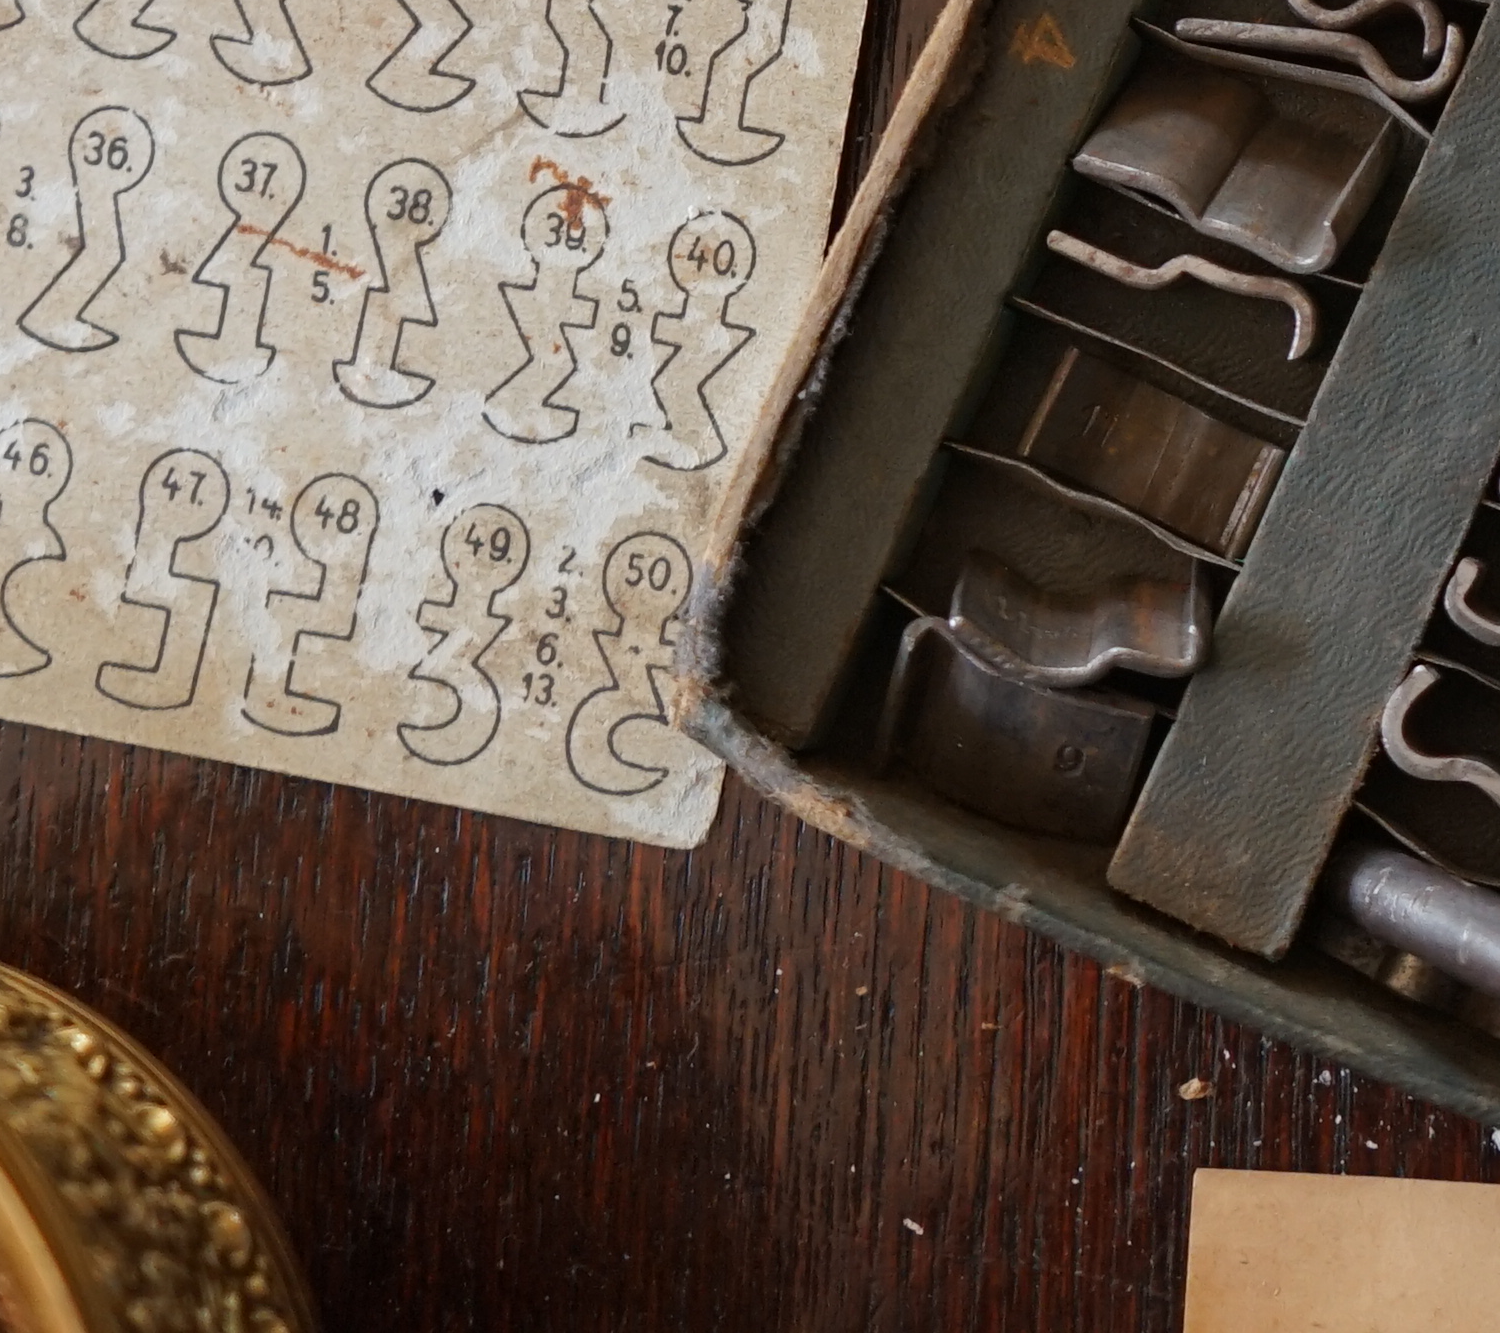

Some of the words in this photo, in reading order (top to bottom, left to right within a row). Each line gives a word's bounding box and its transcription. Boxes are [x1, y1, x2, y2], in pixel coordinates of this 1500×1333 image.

[654, 41, 692, 78] 10.
[1009, 12, 1076, 68] 4
[83, 131, 133, 173] 36.
[234, 157, 279, 200] 37.
[386, 185, 434, 227] 38.
[686, 235, 737, 279] 40.
[2, 440, 53, 479] 46.
[161, 466, 207, 507] 47.
[464, 522, 513, 565] 49.
[624, 552, 677, 596] 50.
